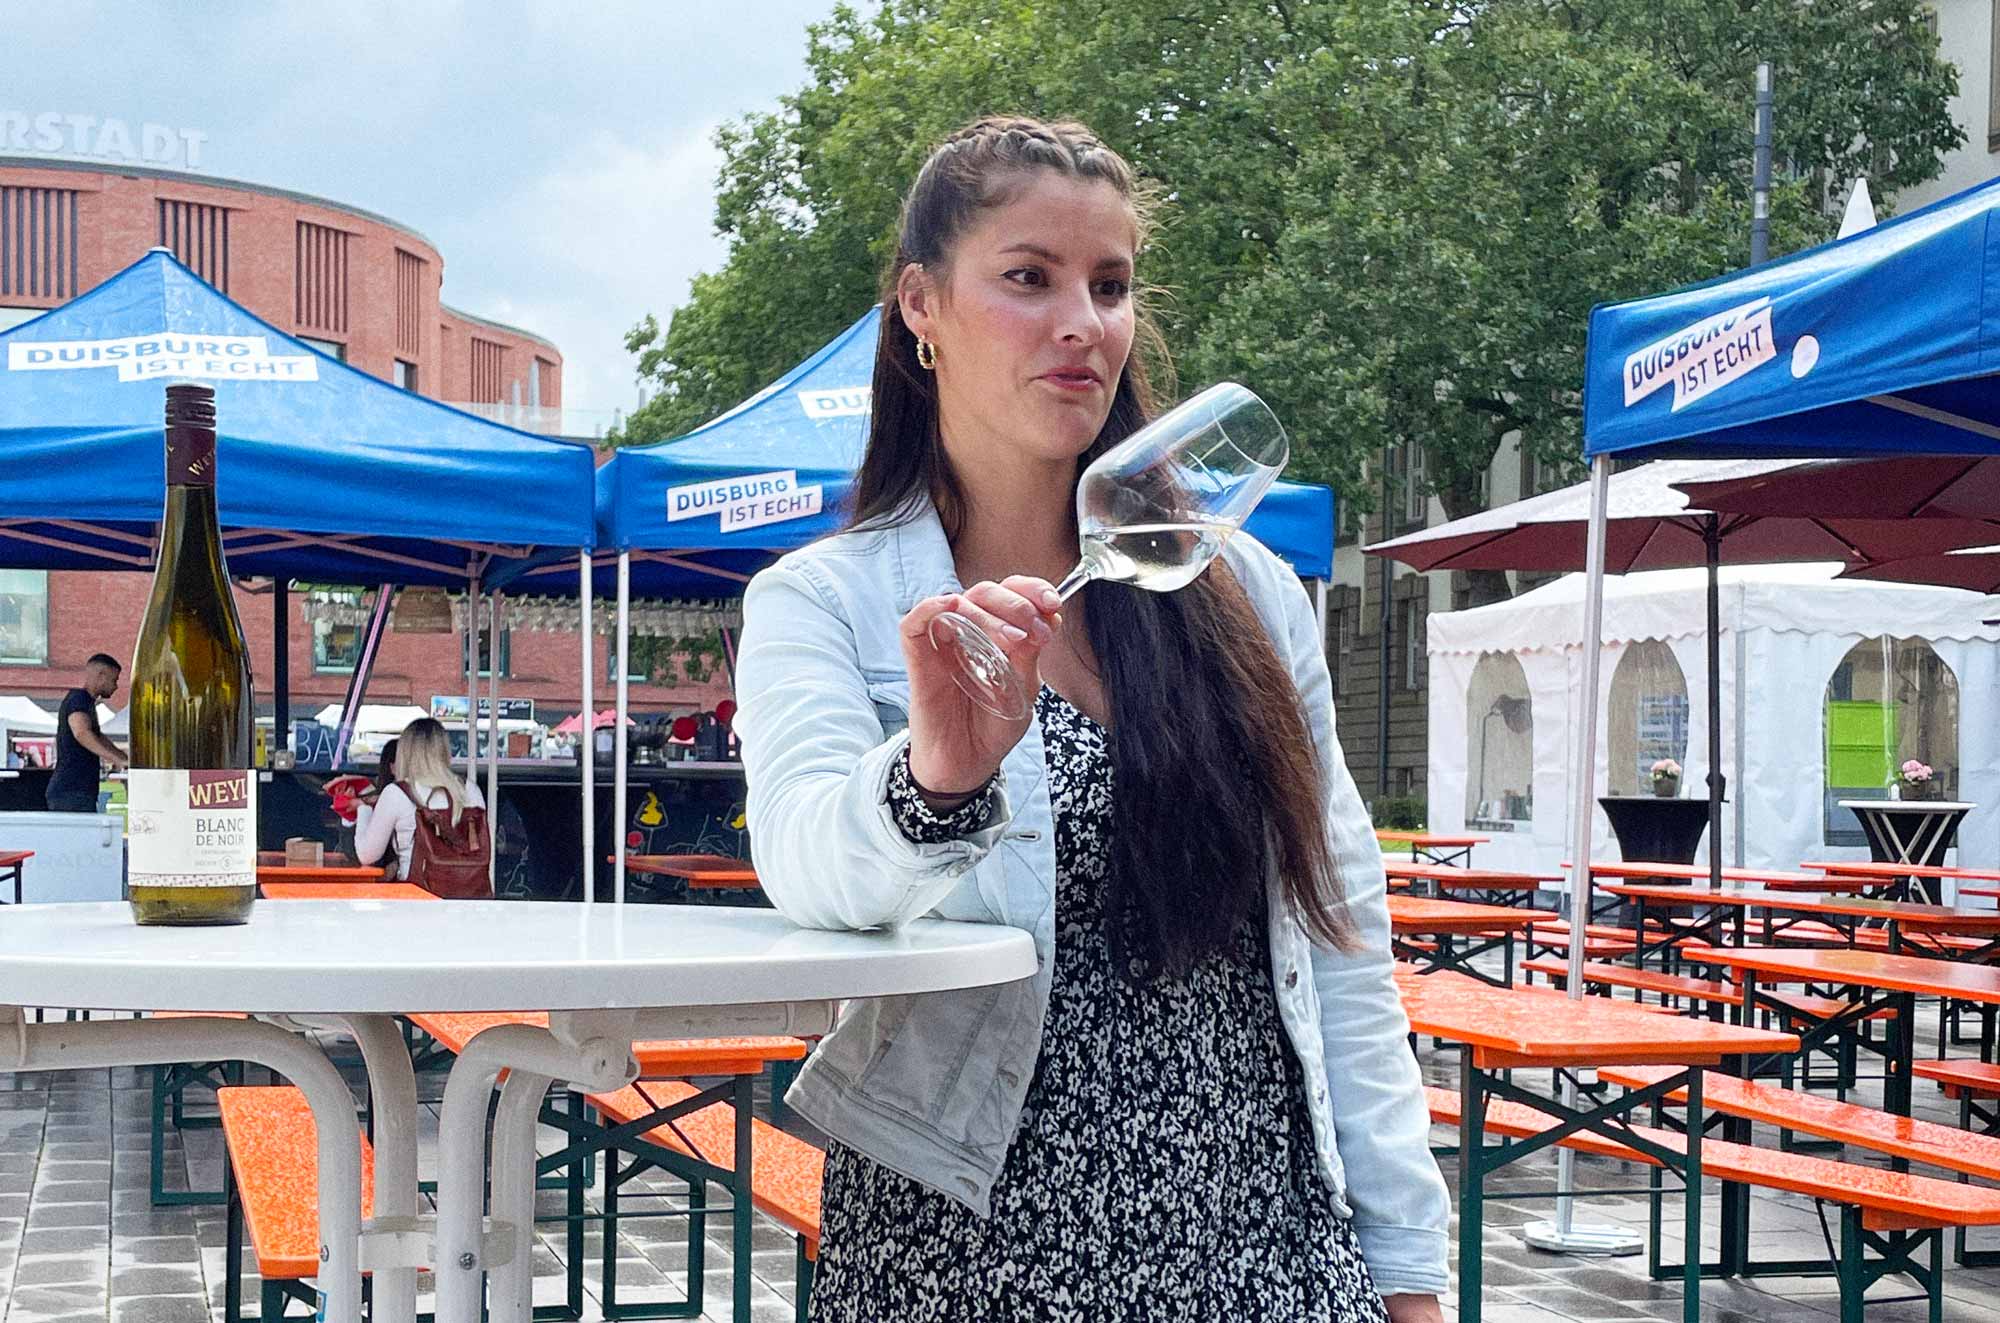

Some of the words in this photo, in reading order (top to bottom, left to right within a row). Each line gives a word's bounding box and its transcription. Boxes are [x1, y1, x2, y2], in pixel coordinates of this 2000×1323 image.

[0, 111, 209, 169] RSTADT
[27, 339, 250, 363] DUISBURG
[1681, 357, 1709, 396] IST
[1714, 323, 1763, 377] ECHT
[136, 357, 191, 375] IST
[205, 360, 300, 375] ECHT
[676, 478, 789, 512] DUISBURG
[728, 503, 758, 524] IST
[764, 492, 814, 517] ECHT
[196, 817, 246, 833] BLANC
[196, 834, 215, 846] DE
[217, 833, 245, 846] NOIR
